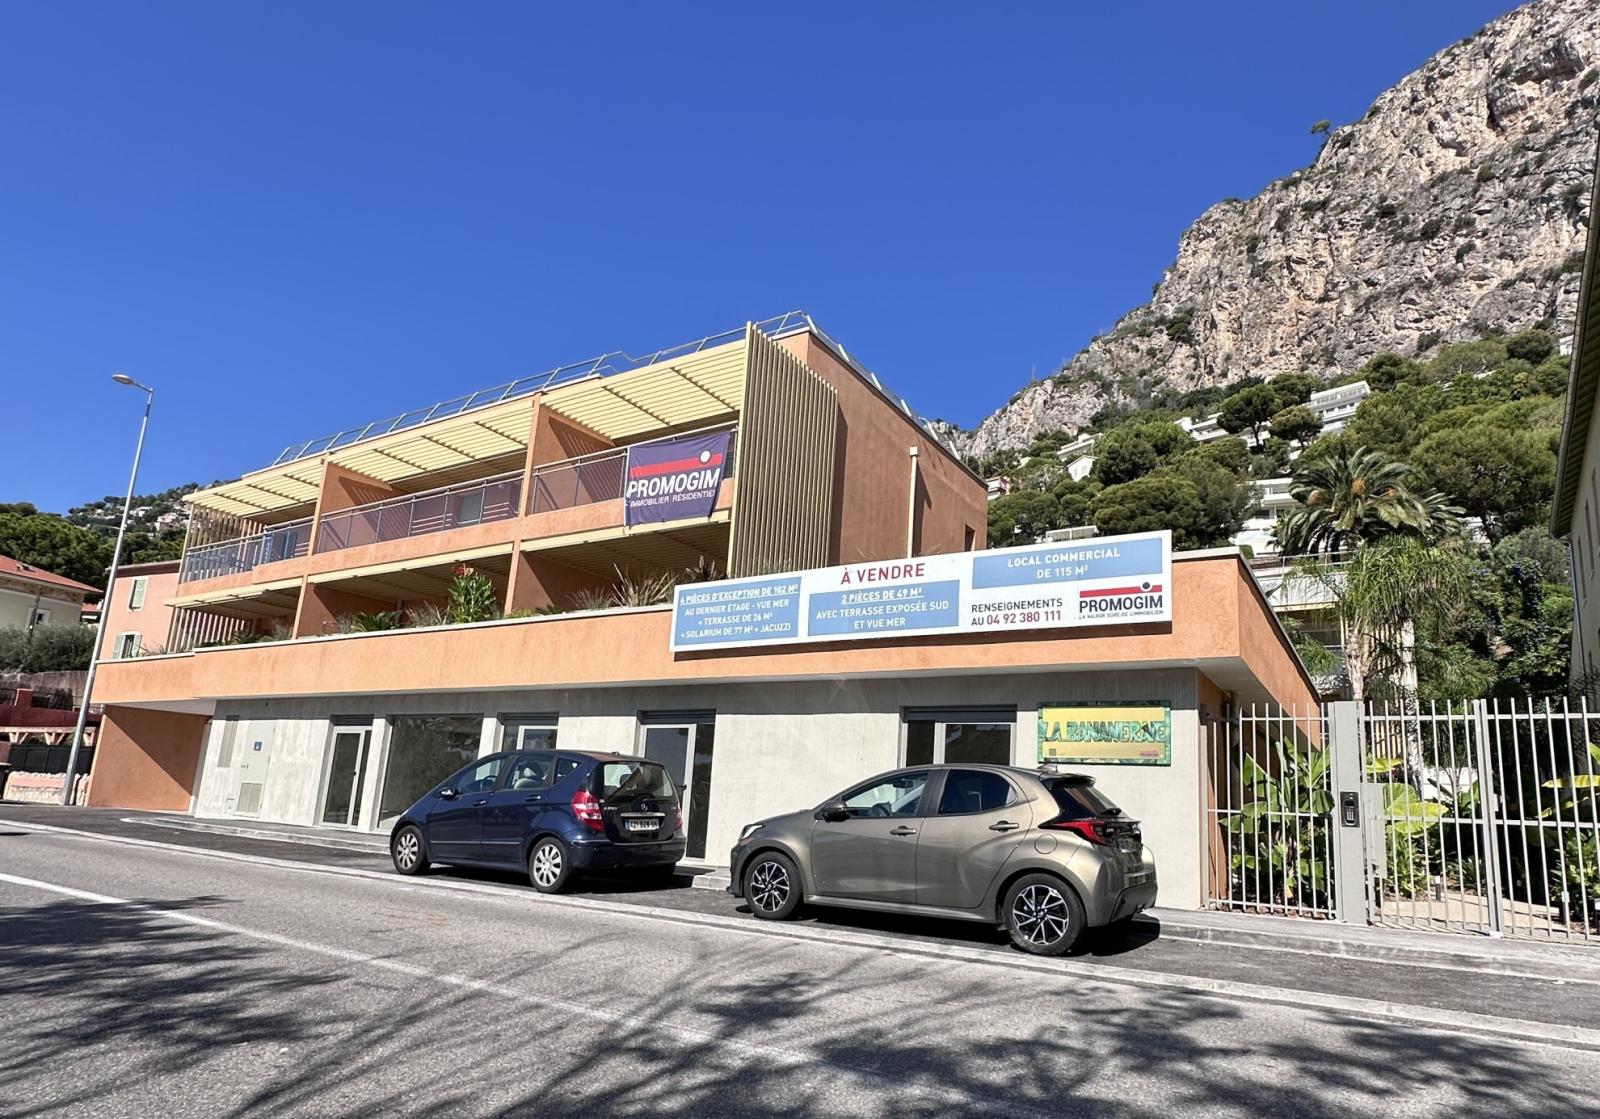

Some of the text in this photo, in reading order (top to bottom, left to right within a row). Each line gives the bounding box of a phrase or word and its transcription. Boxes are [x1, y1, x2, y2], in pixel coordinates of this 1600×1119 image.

[627, 468, 721, 498] PROMOGIM
[630, 496, 670, 508] IMMOBILIER
[1008, 548, 1120, 568] LOCAL COMMERCIAL
[840, 563, 925, 584] À VENDRE
[1037, 565, 1088, 579] DE 115 M²
[687, 592, 711, 603] PIÈCES
[712, 588, 761, 601] D'EXCEPTION
[762, 587, 772, 596] DE
[774, 585, 787, 594] 102
[841, 587, 923, 602] 2 PIÈCES DE 49 M²
[685, 608, 695, 616] AU
[696, 605, 726, 615] DERNIER
[727, 602, 750, 612] ÉTAGE
[757, 600, 771, 609] VUE
[773, 599, 790, 608] MER
[816, 600, 949, 620] AVEC TERRASSE EXPOSÉE SUD
[971, 598, 1063, 613] RENSEIGNEMENTS
[1079, 595, 1163, 613] PROMOGIM
[704, 615, 741, 625] TERRASSE
[742, 613, 753, 622] DE
[854, 617, 906, 630] ET VUE MER
[971, 610, 1061, 626] AU 04 92 380 111
[686, 629, 722, 639] SOLARIUM
[723, 627, 733, 636] DE
[734, 627, 744, 635] 77
[760, 622, 791, 633] JACUZZI
[1041, 721, 1064, 742] LA
